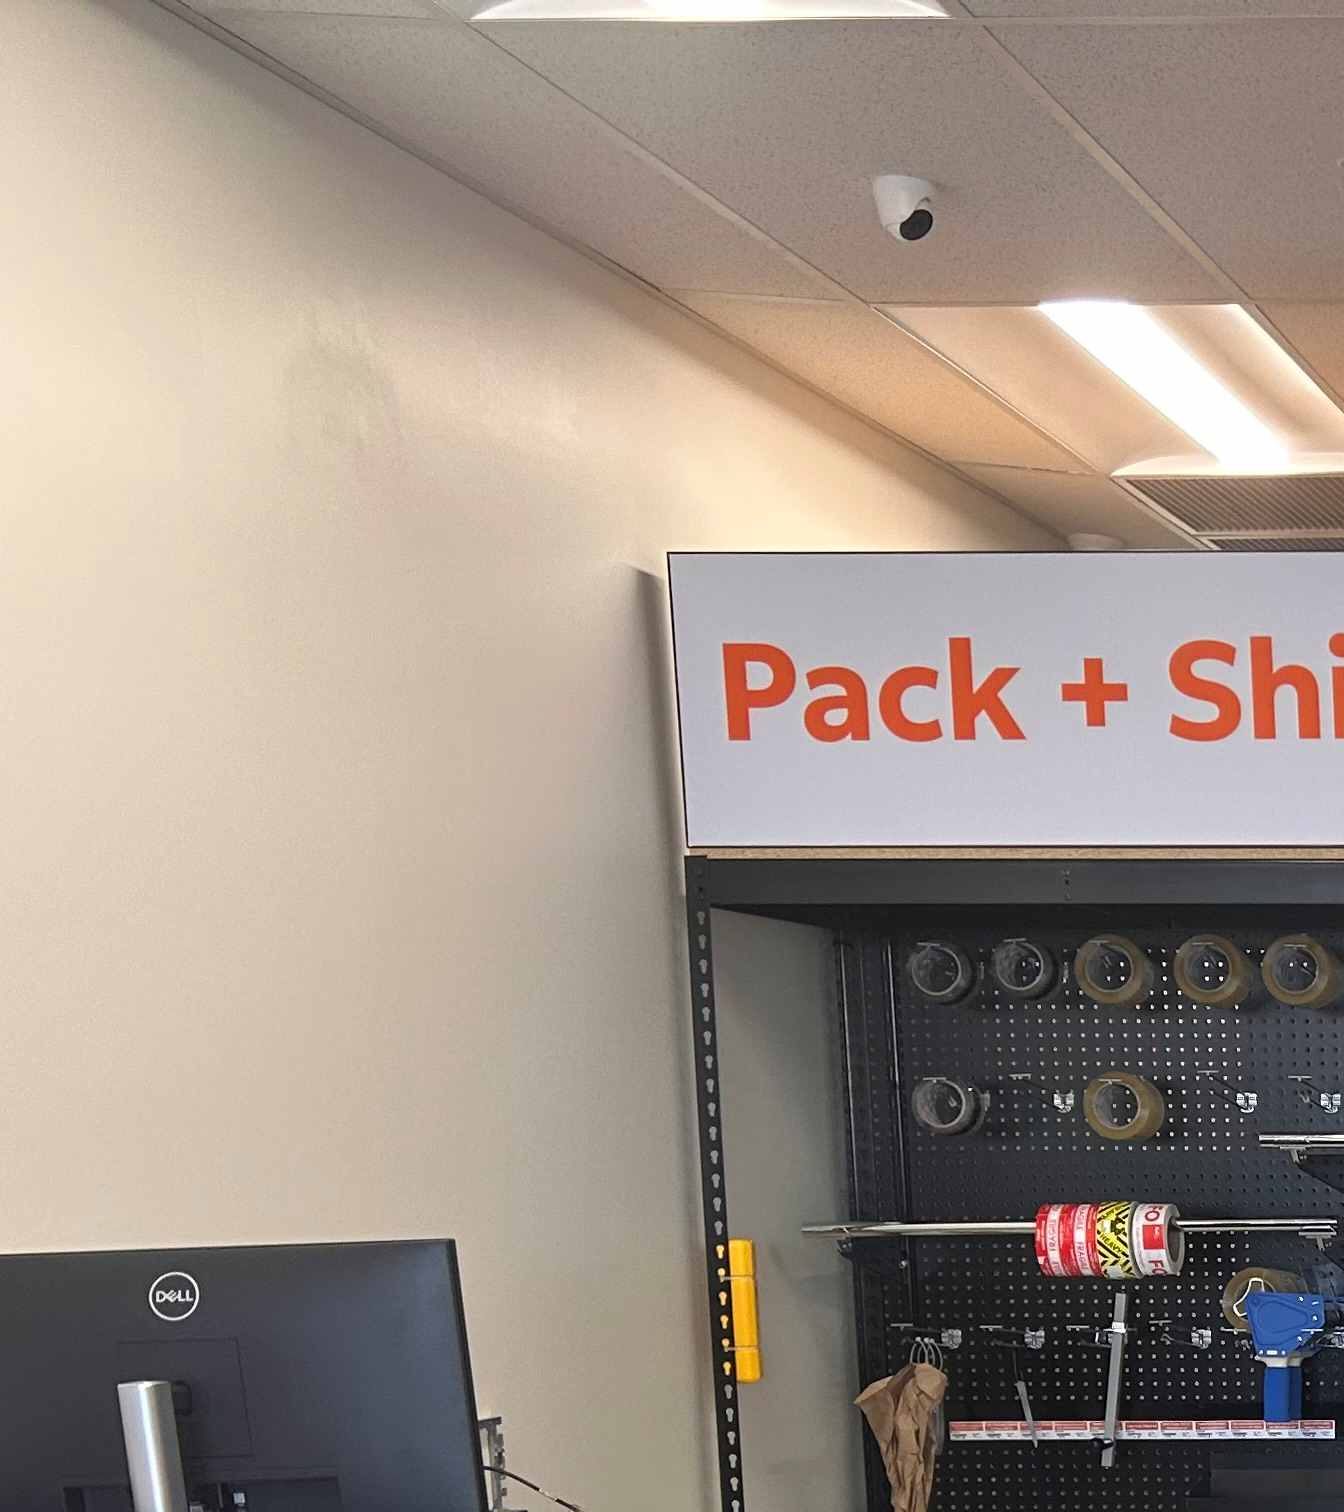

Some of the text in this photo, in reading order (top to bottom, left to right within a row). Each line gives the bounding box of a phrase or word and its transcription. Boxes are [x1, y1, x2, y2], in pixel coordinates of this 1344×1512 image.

[721, 637, 1027, 742] Pack
[1062, 657, 1129, 729] +
[156, 1290, 194, 1302] DELL
